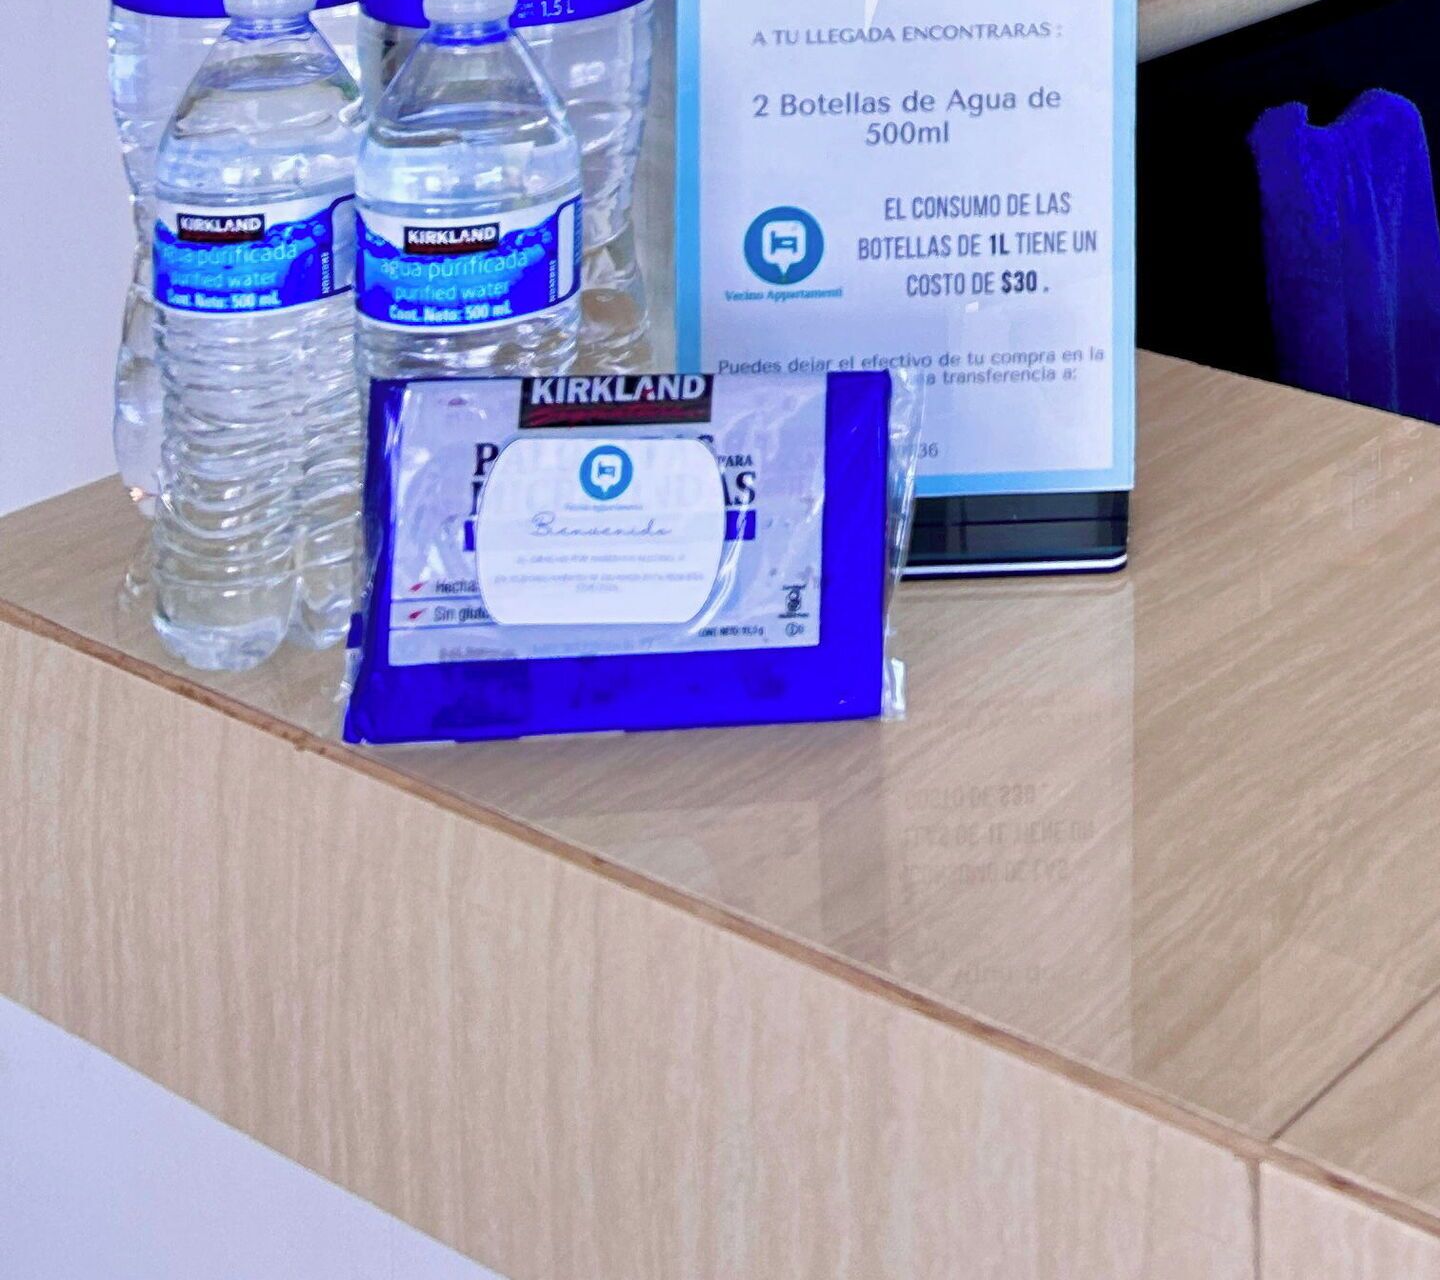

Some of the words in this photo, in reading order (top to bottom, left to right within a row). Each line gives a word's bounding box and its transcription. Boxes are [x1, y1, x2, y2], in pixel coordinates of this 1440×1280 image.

[752, 30, 768, 47] A
[772, 29, 802, 46] TU
[806, 26, 896, 46] LLEGADA
[902, 22, 1053, 42] ENCONTRARAS
[752, 95, 770, 118] 2
[780, 92, 890, 117] Botellas
[902, 90, 936, 113] de
[946, 89, 1018, 119] Agua
[1027, 87, 1063, 110] de
[864, 121, 951, 146] 500ml
[884, 197, 907, 221] EL
[911, 194, 1001, 220] CONSUMO
[1006, 193, 1031, 217] DE
[1035, 192, 1072, 216] LAS
[180, 217, 263, 232] KIRKLAND
[407, 226, 498, 245] KIRKLAND
[857, 234, 952, 261] BOTELLAS
[957, 233, 982, 257] DE
[988, 233, 1011, 256] 1L
[1015, 231, 1068, 255] TIENE
[1073, 230, 1098, 253] UN
[380, 259, 423, 280] agua
[428, 251, 529, 282] purificada
[394, 284, 457, 303] purified
[462, 281, 511, 299] water
[906, 273, 967, 299] COSTO
[971, 272, 995, 296] DE
[1001, 270, 1038, 295] $30
[717, 357, 783, 376] Puedes
[838, 354, 855, 371] el
[861, 352, 934, 371] efectivo
[938, 351, 962, 368] de
[967, 351, 985, 367] tu
[989, 351, 1057, 371] compra
[1061, 348, 1084, 364] en
[1089, 345, 1106, 361] la
[530, 374, 707, 405] KIRKLAND
[942, 367, 1057, 386] transferencia
